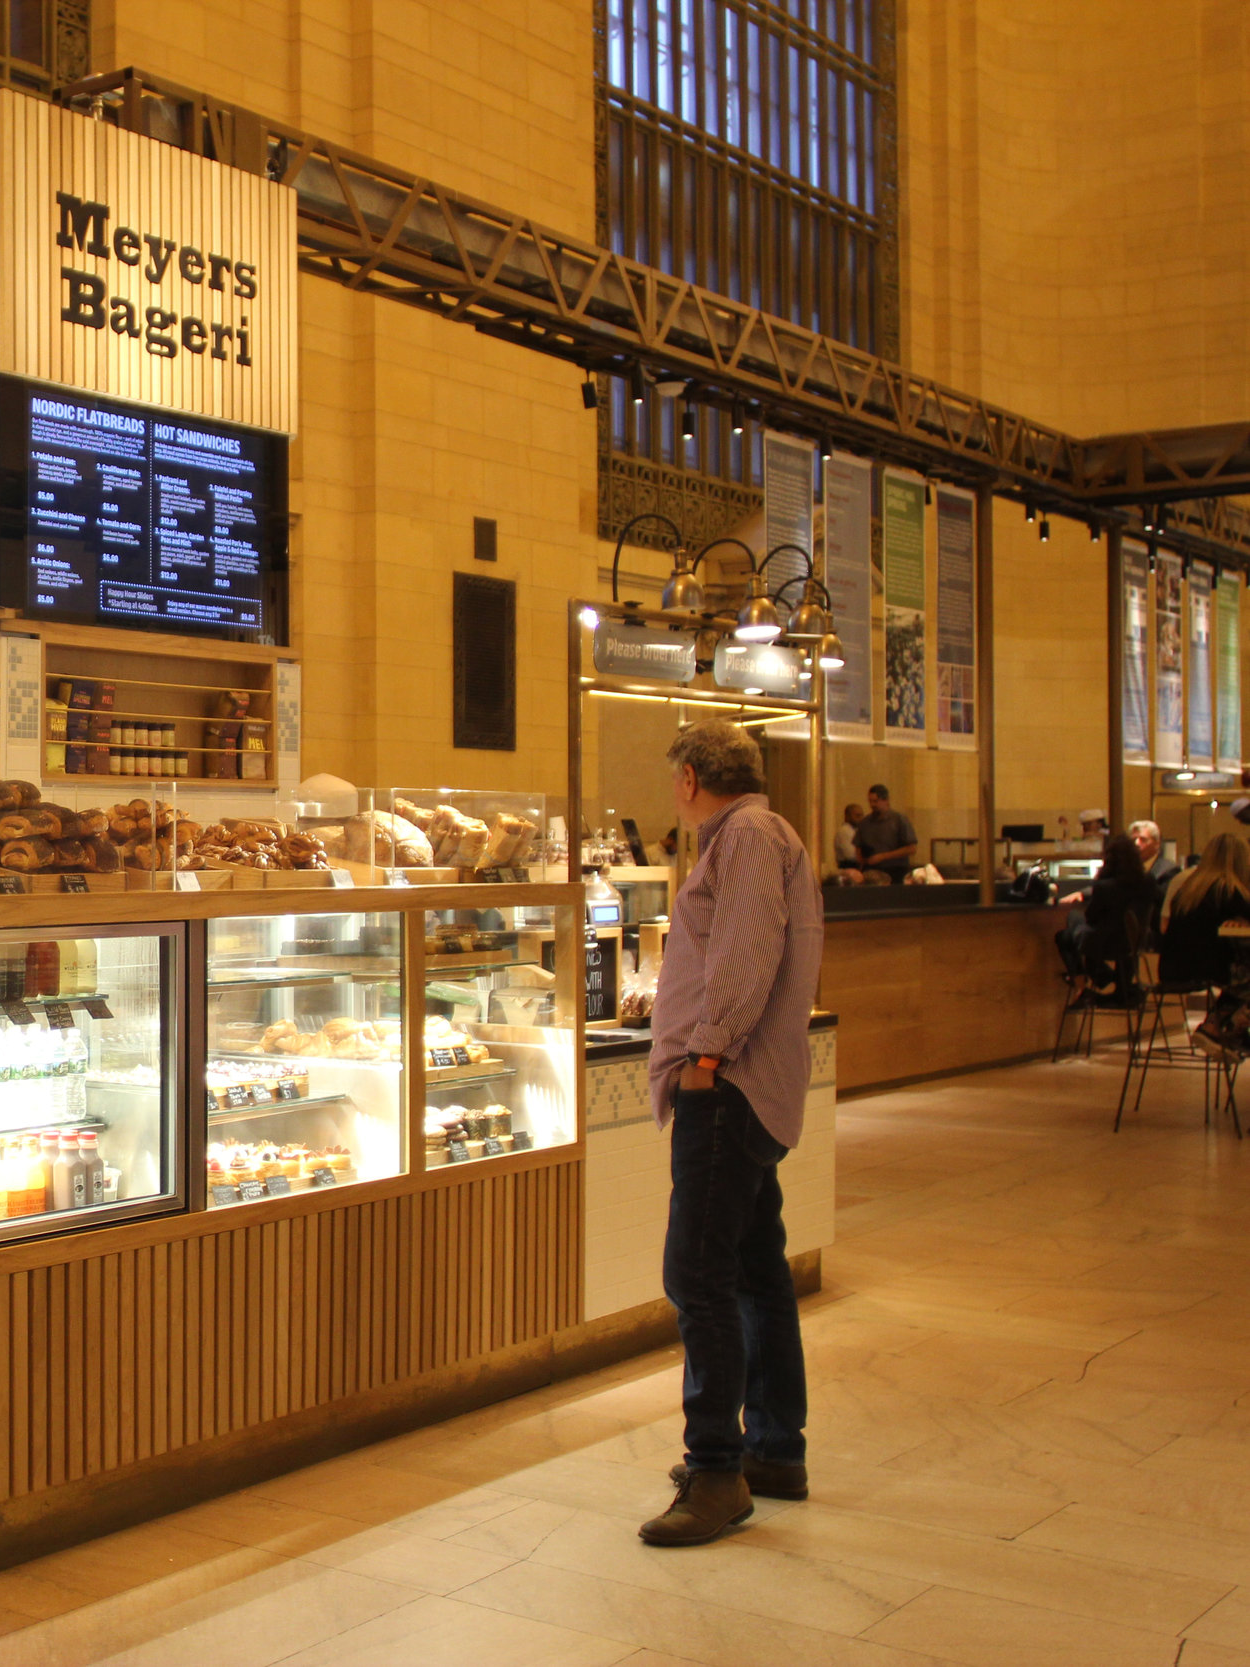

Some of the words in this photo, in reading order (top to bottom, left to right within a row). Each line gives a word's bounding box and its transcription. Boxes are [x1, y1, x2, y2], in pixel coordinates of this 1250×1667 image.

[56, 190, 258, 300] Meyers
[61, 266, 252, 366] Bageri
[32, 398, 75, 420] NORDIC
[77, 406, 145, 434] FLATBREADS
[155, 423, 175, 440] HOT
[176, 428, 240, 454] SANDWICHES
[36, 451, 53, 461] Potato
[53, 454, 62, 463] and
[102, 463, 127, 474] Cauliflower
[159, 474, 178, 484] Pastrami
[37, 490, 54, 501] $5.00
[102, 502, 118, 512] $5.00
[36, 508, 58, 517] Zucchini
[58, 511, 67, 519] and
[68, 512, 85, 522] Cheese
[102, 518, 119, 527] Tomato
[37, 558, 52, 566] Arctic
[108, 588, 124, 598] Happy
[38, 594, 54, 604] $5.00
[606, 638, 641, 658] Please
